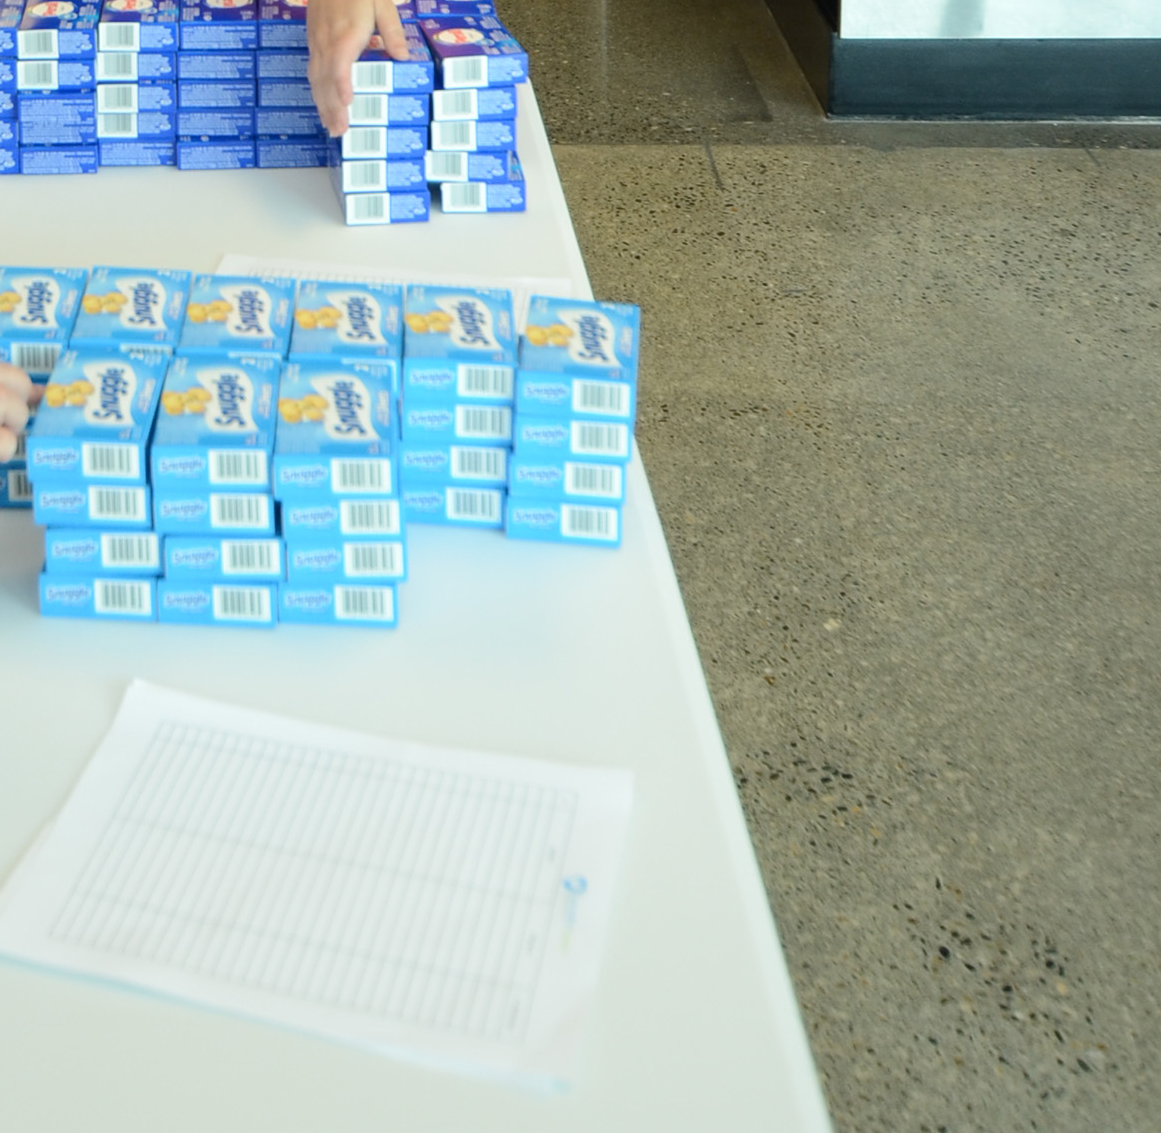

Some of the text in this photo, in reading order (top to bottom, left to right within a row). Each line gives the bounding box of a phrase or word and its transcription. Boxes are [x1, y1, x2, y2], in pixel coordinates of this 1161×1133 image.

[20, 280, 54, 324] Snuggle
[127, 282, 159, 326] Snuggle
[234, 289, 265, 334] Snuggle
[344, 296, 376, 340] Snuggle
[458, 300, 491, 347] Snuggle
[577, 314, 610, 363] Snuggle
[93, 367, 130, 421] Snuggle
[214, 373, 246, 427] Snuggle
[332, 380, 368, 435] Snuggle
